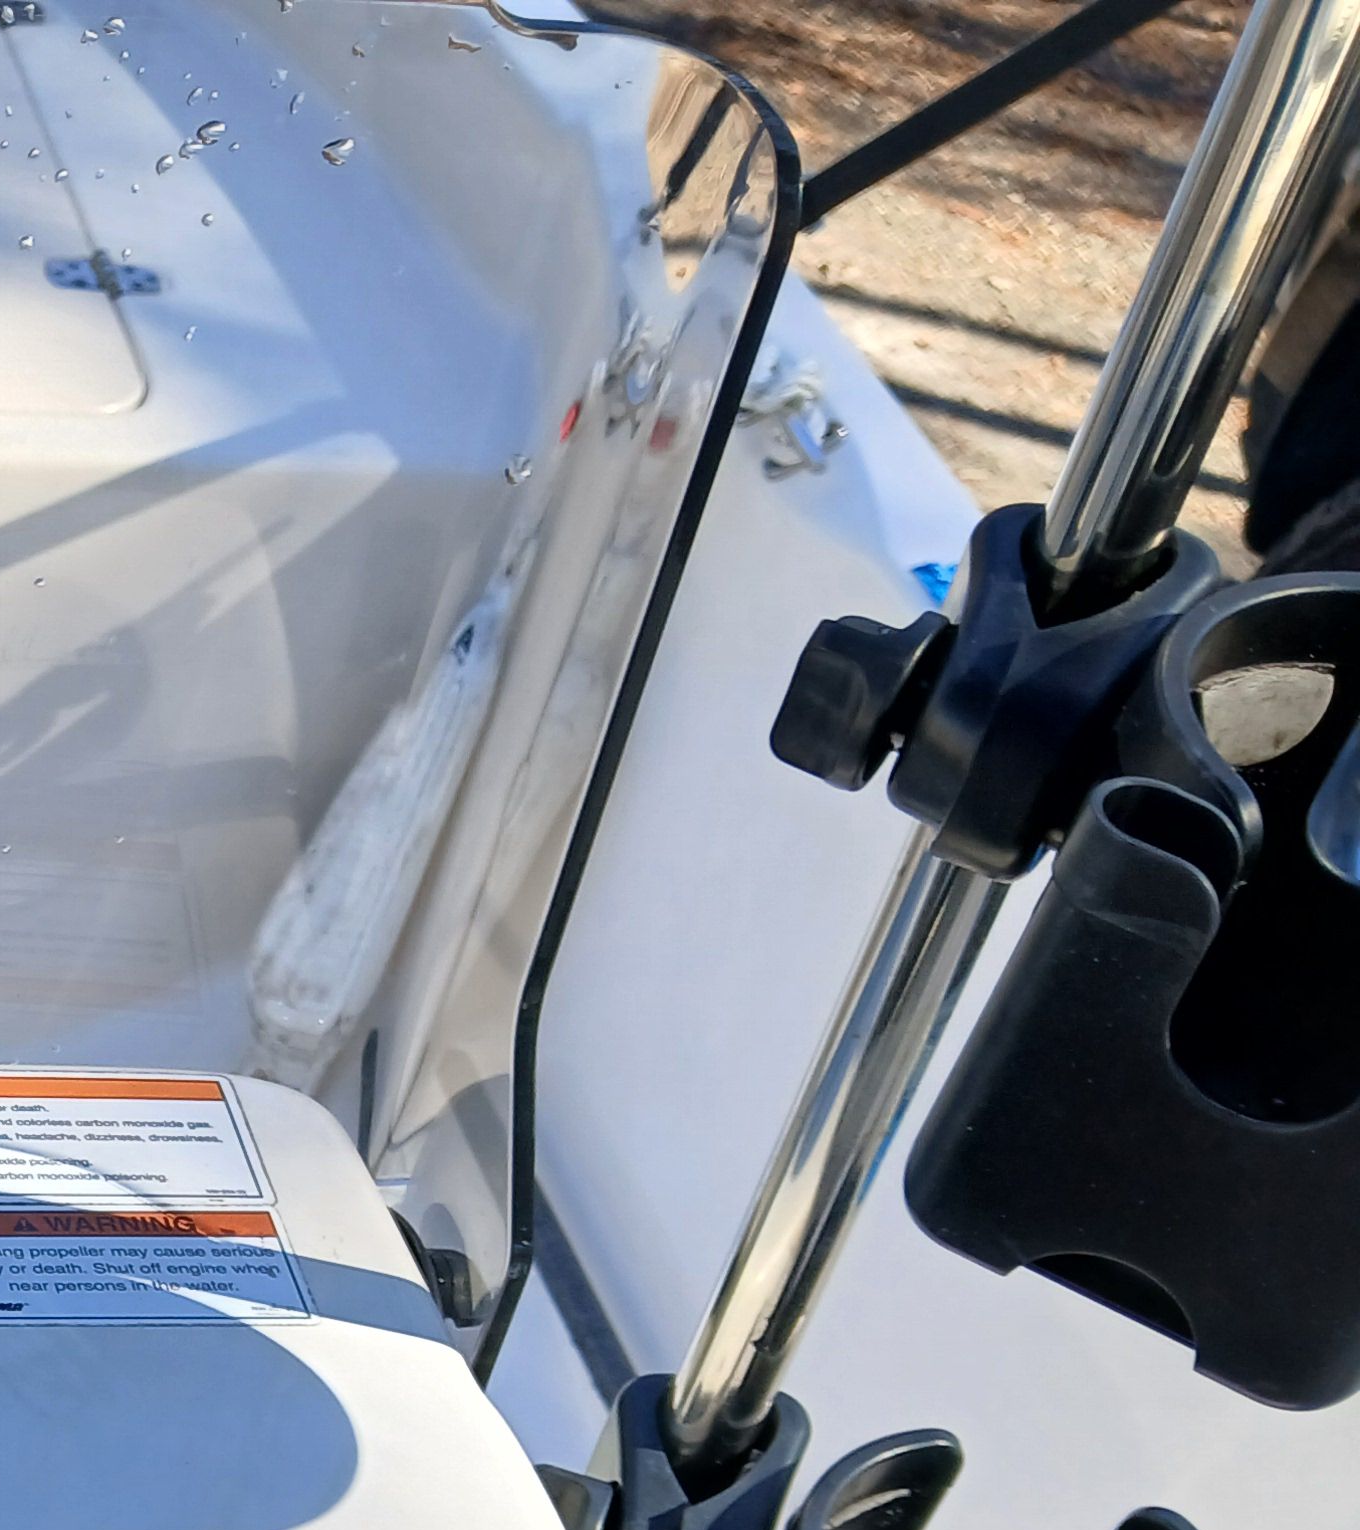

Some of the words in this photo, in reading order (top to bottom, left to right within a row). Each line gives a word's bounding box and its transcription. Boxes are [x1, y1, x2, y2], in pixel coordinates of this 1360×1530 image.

[123, 1120, 184, 1128] monoxide
[103, 1174, 168, 1183] poisoning.
[43, 1216, 197, 1232] WARNING
[30, 1246, 104, 1259] propeller
[111, 1248, 147, 1260] may
[153, 1247, 206, 1257] cause
[211, 1247, 275, 1257] serious
[9, 1264, 26, 1274] or
[32, 1263, 87, 1274] death.
[93, 1262, 135, 1274] Shut
[139, 1263, 162, 1274] off
[166, 1263, 227, 1276] engine
[232, 1263, 280, 1275] when
[9, 1282, 49, 1291] near
[54, 1282, 127, 1294] persons
[132, 1281, 148, 1291] in
[152, 1280, 179, 1291] the
[185, 1281, 239, 1291] water.
